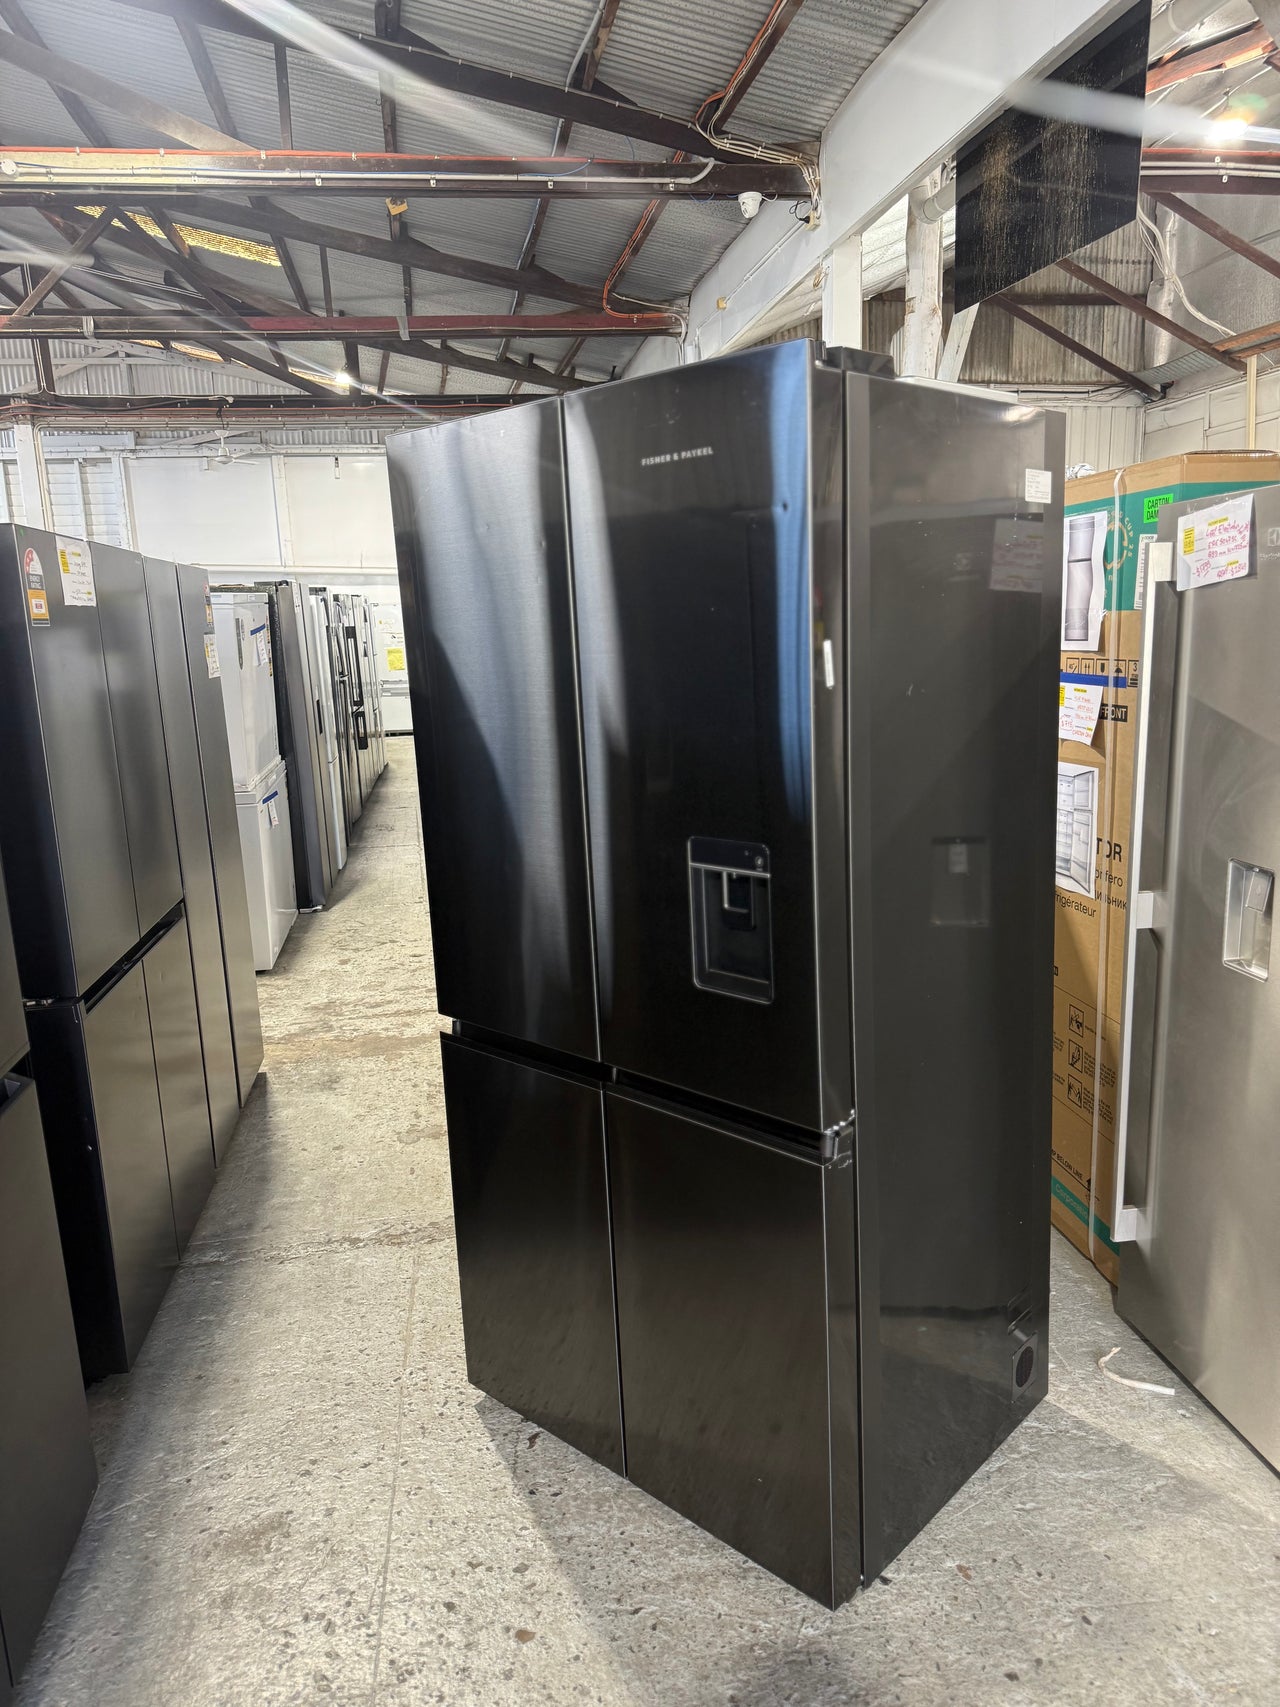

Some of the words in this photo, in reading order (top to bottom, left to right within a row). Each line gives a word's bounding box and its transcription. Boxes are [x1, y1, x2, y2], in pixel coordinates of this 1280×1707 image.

[641, 454, 671, 466] FISHER
[673, 452, 679, 461] &
[681, 446, 714, 460] PAYKEL
[1147, 496, 1170, 510] CARTON
[1101, 706, 1127, 720] FRONT
